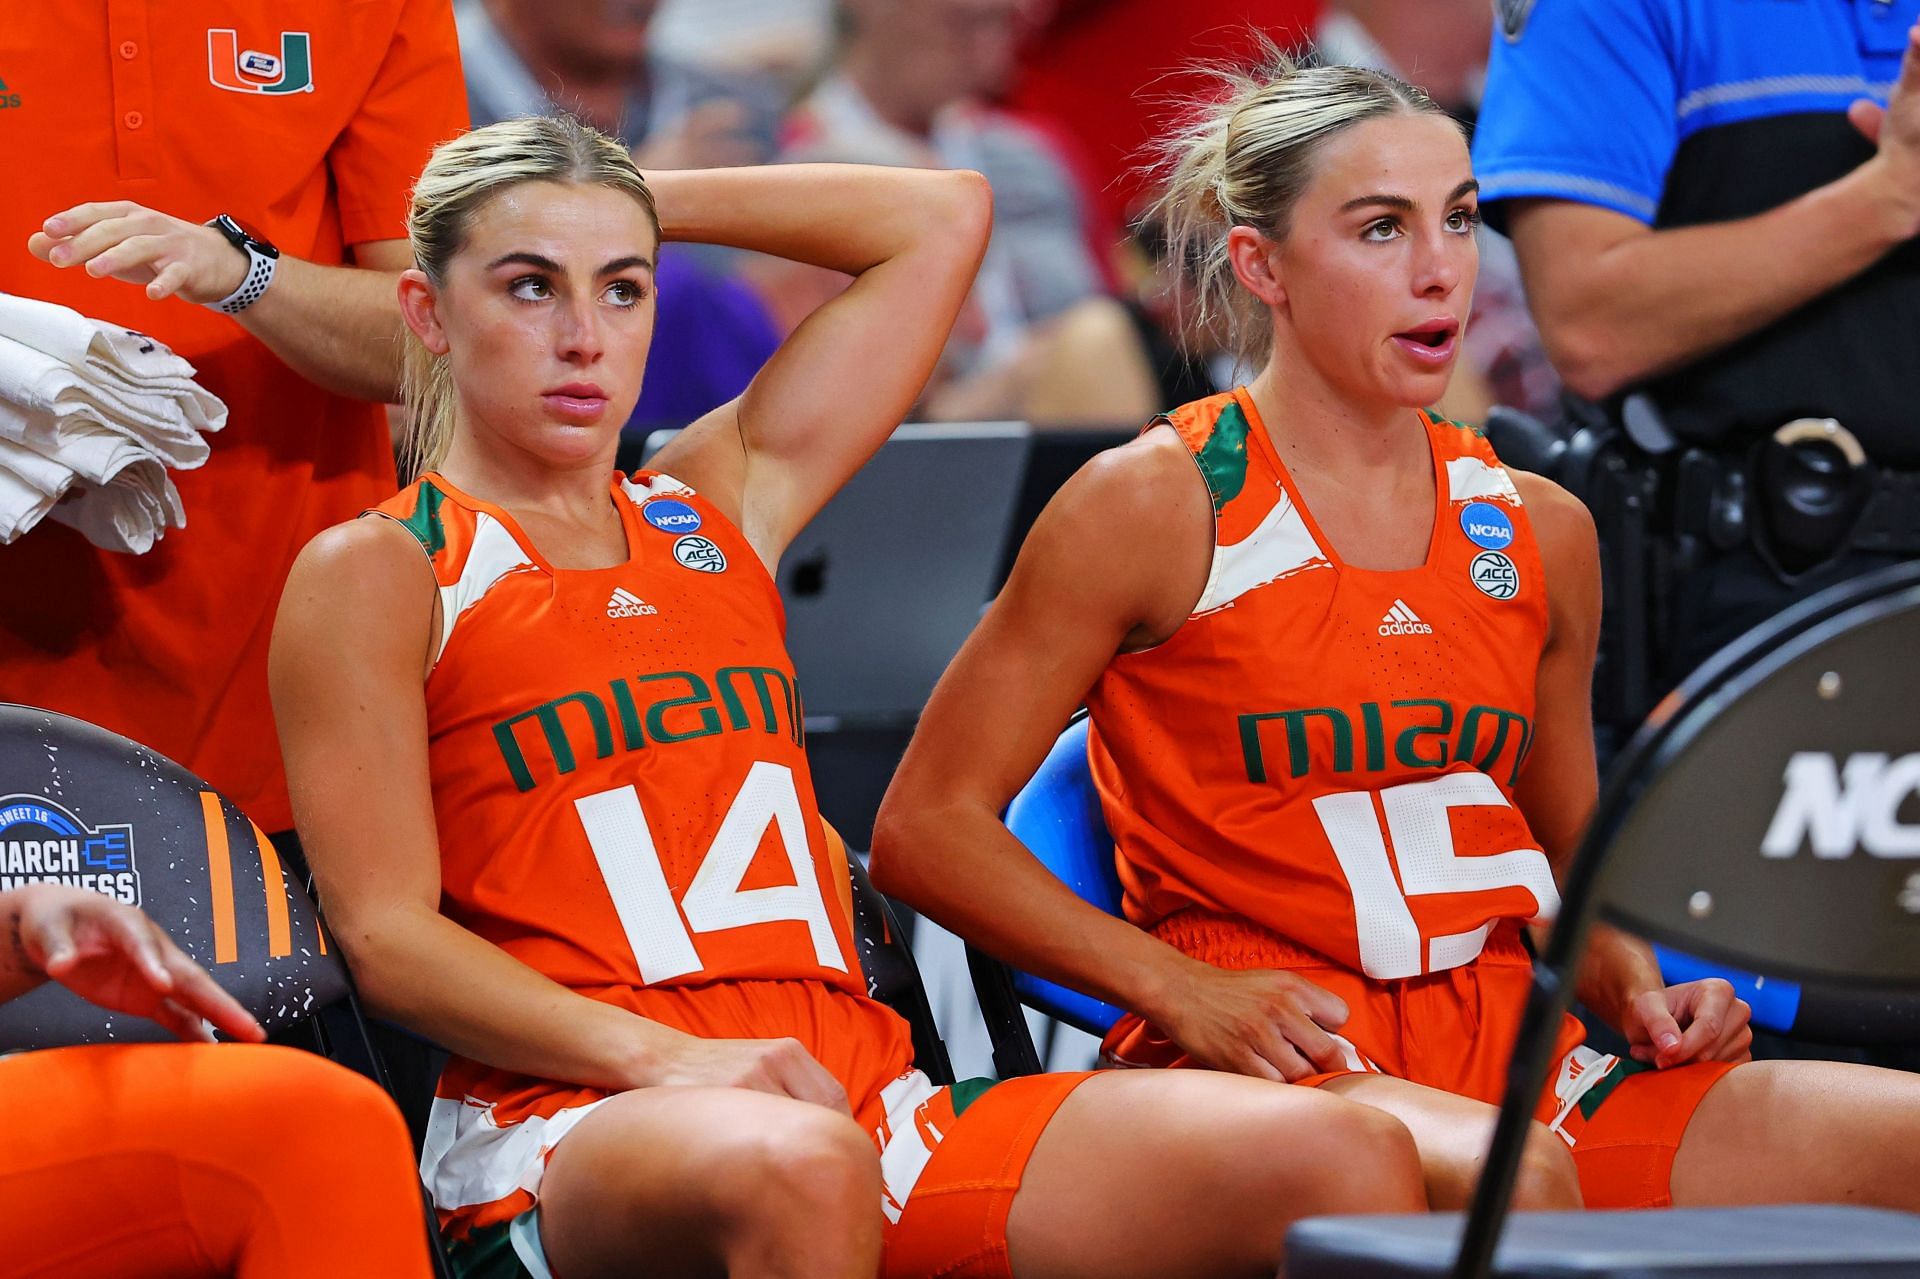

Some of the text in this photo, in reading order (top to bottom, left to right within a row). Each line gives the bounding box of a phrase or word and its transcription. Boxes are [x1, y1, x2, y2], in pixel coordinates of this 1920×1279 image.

[207, 28, 311, 95] U
[654, 514, 699, 526] NCAA
[1469, 523, 1511, 539] NCAA
[685, 548, 718, 561] ACC
[1478, 568, 1513, 580] ACC
[607, 604, 658, 619] adidas
[1378, 621, 1433, 638] adidas
[0, 807, 48, 826] SWEET 16
[573, 760, 849, 985] 14
[1311, 772, 1562, 980] 15
